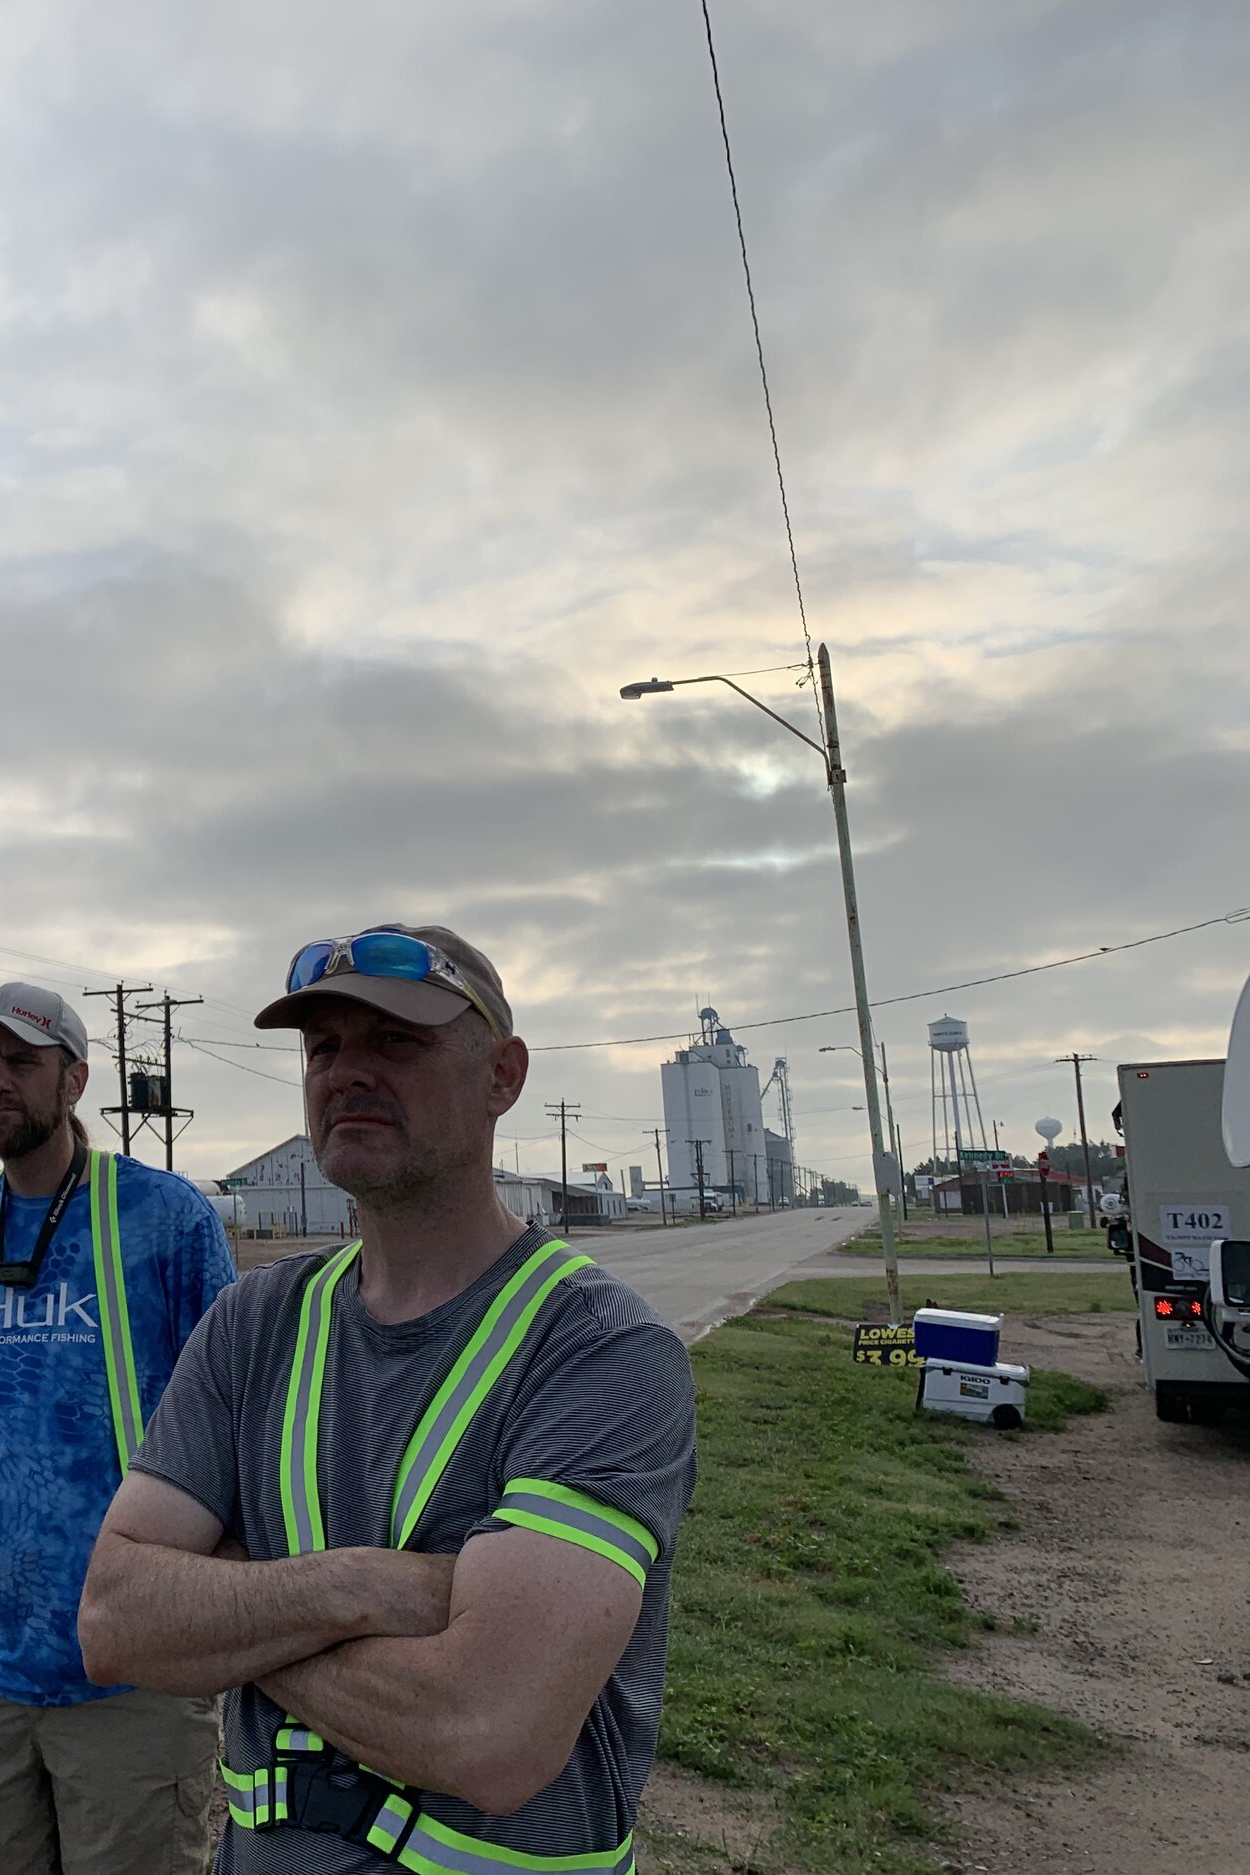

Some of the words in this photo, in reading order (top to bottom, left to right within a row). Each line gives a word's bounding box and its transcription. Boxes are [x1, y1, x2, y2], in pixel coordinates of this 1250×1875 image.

[12, 1006, 42, 1023] Hurley
[960, 1151, 993, 1160] Kennedy
[995, 1151, 1004, 1160] Dr
[1166, 1213, 1223, 1229] T402
[51, 1333, 96, 1343] FISHING
